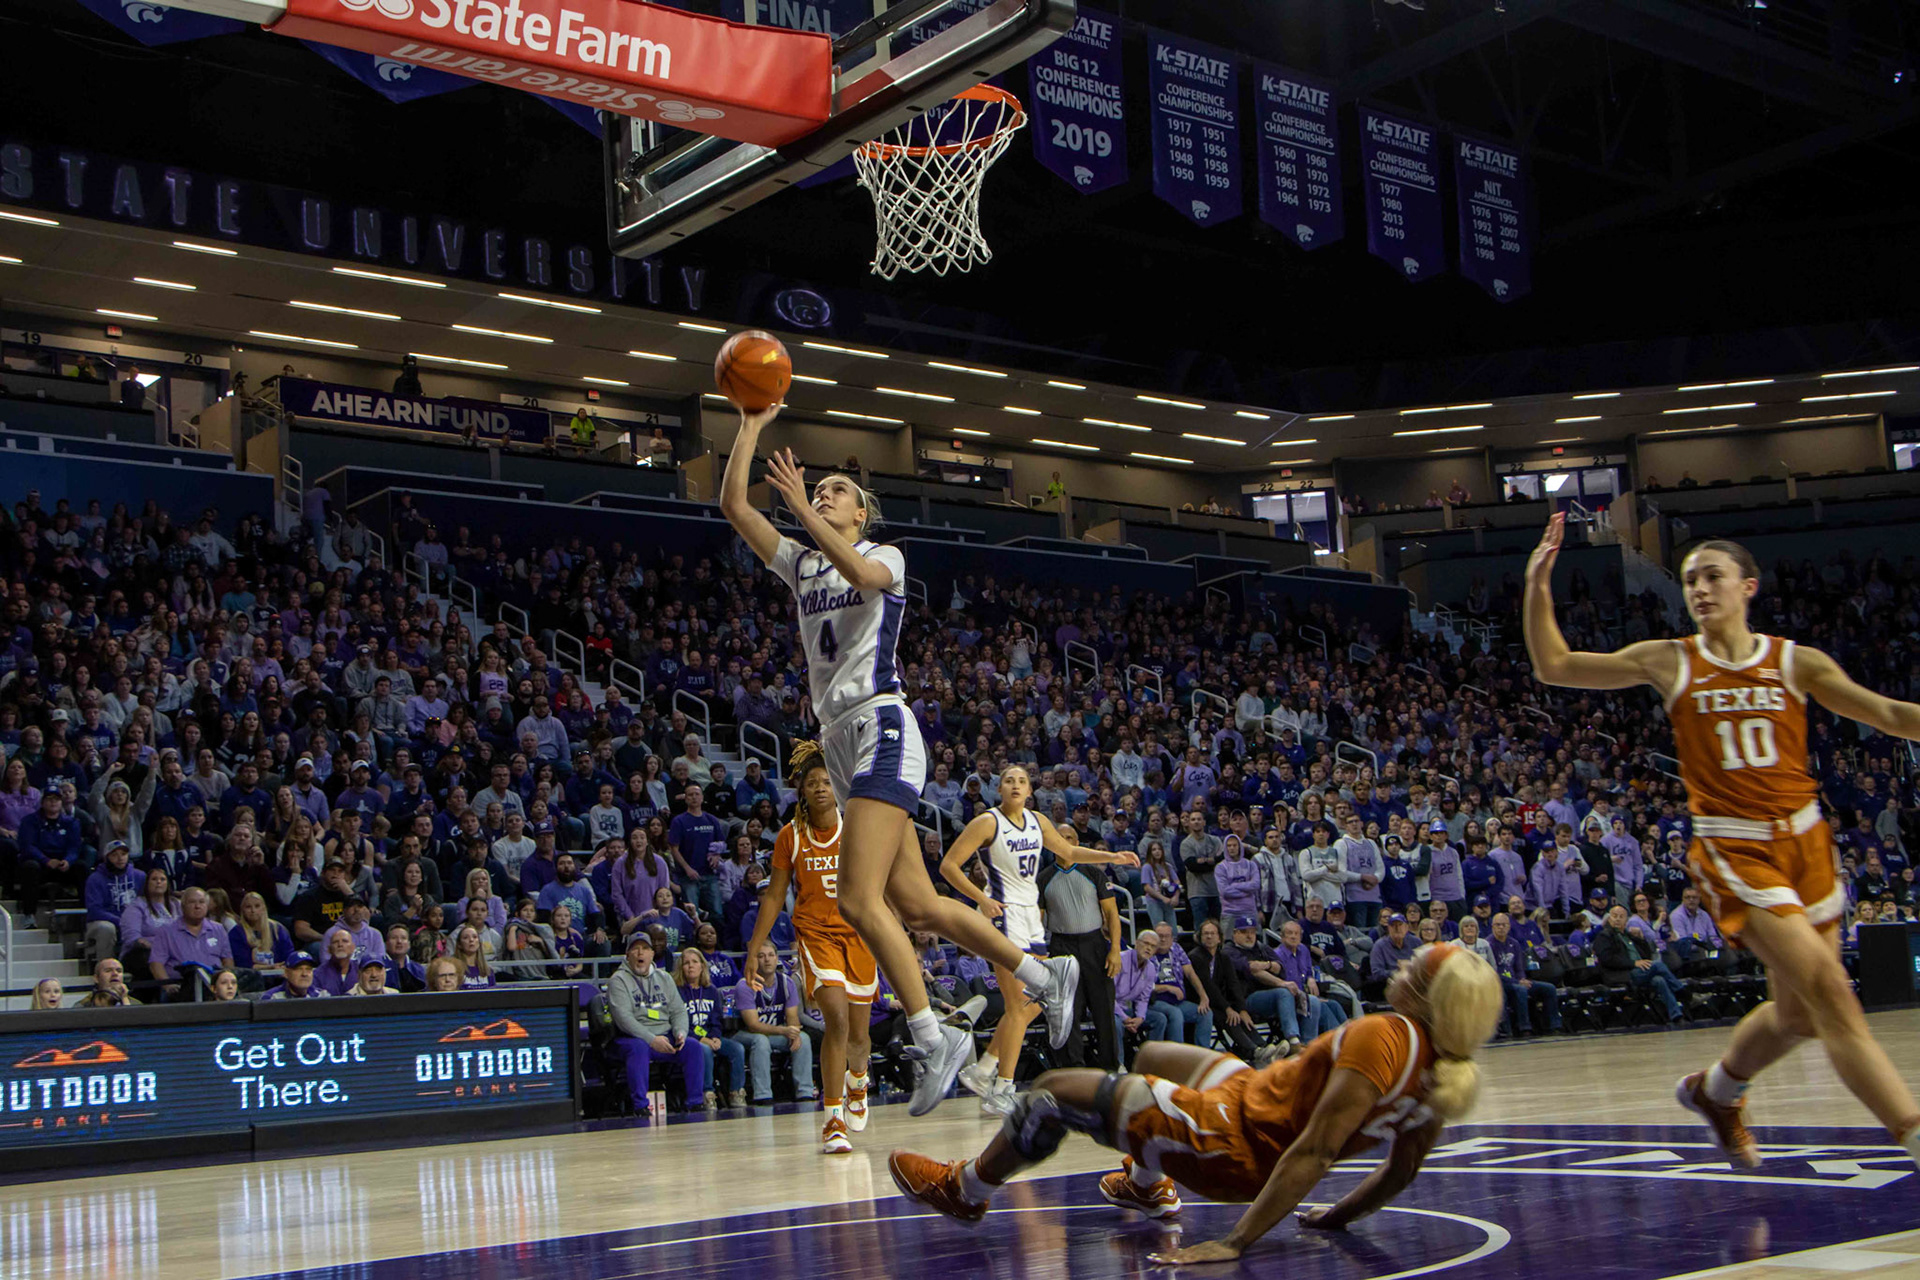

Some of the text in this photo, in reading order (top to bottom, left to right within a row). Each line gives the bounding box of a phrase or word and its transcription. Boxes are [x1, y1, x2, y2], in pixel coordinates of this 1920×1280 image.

[1054, 49, 1100, 77] BIG 12
[1156, 44, 1230, 80] K-STATE
[1036, 65, 1121, 99] CONFERENCE
[1184, 68, 1226, 88] BASKETBALL
[1036, 81, 1123, 120] CHAMPIONS
[1165, 82, 1225, 108] CONFERENCE
[1262, 74, 1330, 109] K-STATE
[1158, 92, 1233, 122] CHAMPIONSHIPS
[1168, 117, 1225, 142] 1917 1951
[1263, 120, 1335, 148] CHAMPIONSHIPS
[1271, 111, 1326, 135] CONFERENCE
[1366, 115, 1430, 148] K-STATE
[1051, 118, 1112, 158] 2019
[1168, 133, 1227, 158] 1919 1956
[1169, 149, 1229, 174] 1948 1958
[1274, 145, 1327, 168] 1960 1968
[1376, 151, 1428, 173] CONFERENCE
[1460, 141, 1518, 172] K-STATE
[1170, 165, 1230, 190] 1950 1959
[1275, 160, 1329, 183] 1961 1970
[1369, 160, 1436, 186] CHAMPIONSHIPS
[1276, 175, 1331, 199] 1963 1972
[1379, 182, 1401, 197] 1977
[1483, 180, 1503, 197] NIT
[1277, 191, 1332, 213] 1964 1973
[1380, 197, 1403, 211] 1980
[1471, 205, 1491, 219] 1976
[1, 143, 706, 312] STATE UNIVERSITY
[1382, 211, 1404, 226] 2013
[1383, 225, 1406, 241] 2019
[21, 331, 41, 345] 19
[185, 352, 203, 366] 20
[311, 388, 511, 437] AHEARNFUND
[646, 413, 661, 425] 21
[984, 456, 996, 469] 22
[1510, 462, 1526, 473] 22
[1593, 456, 1608, 467] 23
[1260, 483, 1275, 493] 22
[1300, 480, 1315, 491] 22
[800, 587, 865, 617] Wildcats
[819, 619, 838, 663] 4
[489, 679, 504, 692] 22
[1691, 686, 1787, 714] TEXAS
[1714, 717, 1780, 771] 10
[1018, 855, 1037, 878] 50
[1440, 861, 1454, 875] 22
[1669, 868, 1684, 880] 24
[821, 873, 838, 898] 5
[214, 1032, 366, 1073] Get Out
[415, 1046, 555, 1083] OUTDOOR
[232, 1075, 351, 1112] There.
[454, 1084, 518, 1098] BANK
[32, 1111, 113, 1130] BANK
